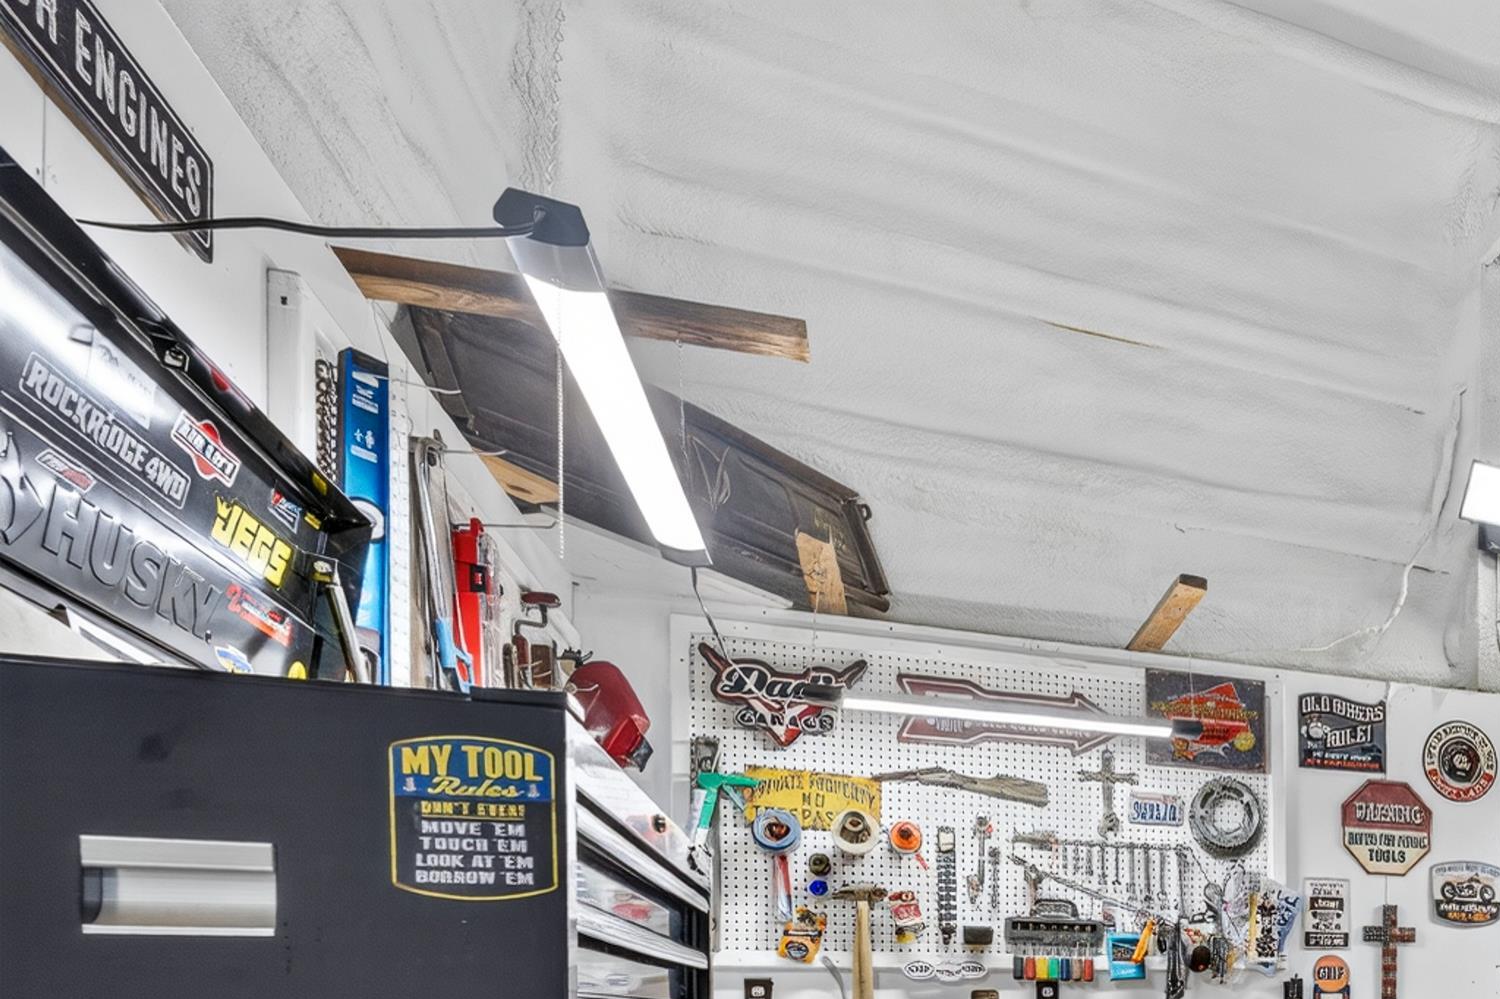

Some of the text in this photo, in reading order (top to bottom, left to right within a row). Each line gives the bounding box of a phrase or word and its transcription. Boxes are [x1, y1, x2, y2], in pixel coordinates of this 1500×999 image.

[75, 8, 201, 218] ENGINES
[144, 456, 188, 501] 4WD
[211, 496, 293, 590] JEGS
[41, 484, 223, 641] HUSKY
[401, 745, 544, 781] MY TOOL
[427, 777, 526, 798] Rules
[421, 821, 482, 835] MOVE
[419, 836, 489, 852] TOUCH
[415, 852, 464, 868] LOOK
[471, 854, 495, 869] AT
[415, 871, 496, 885] BORROW
